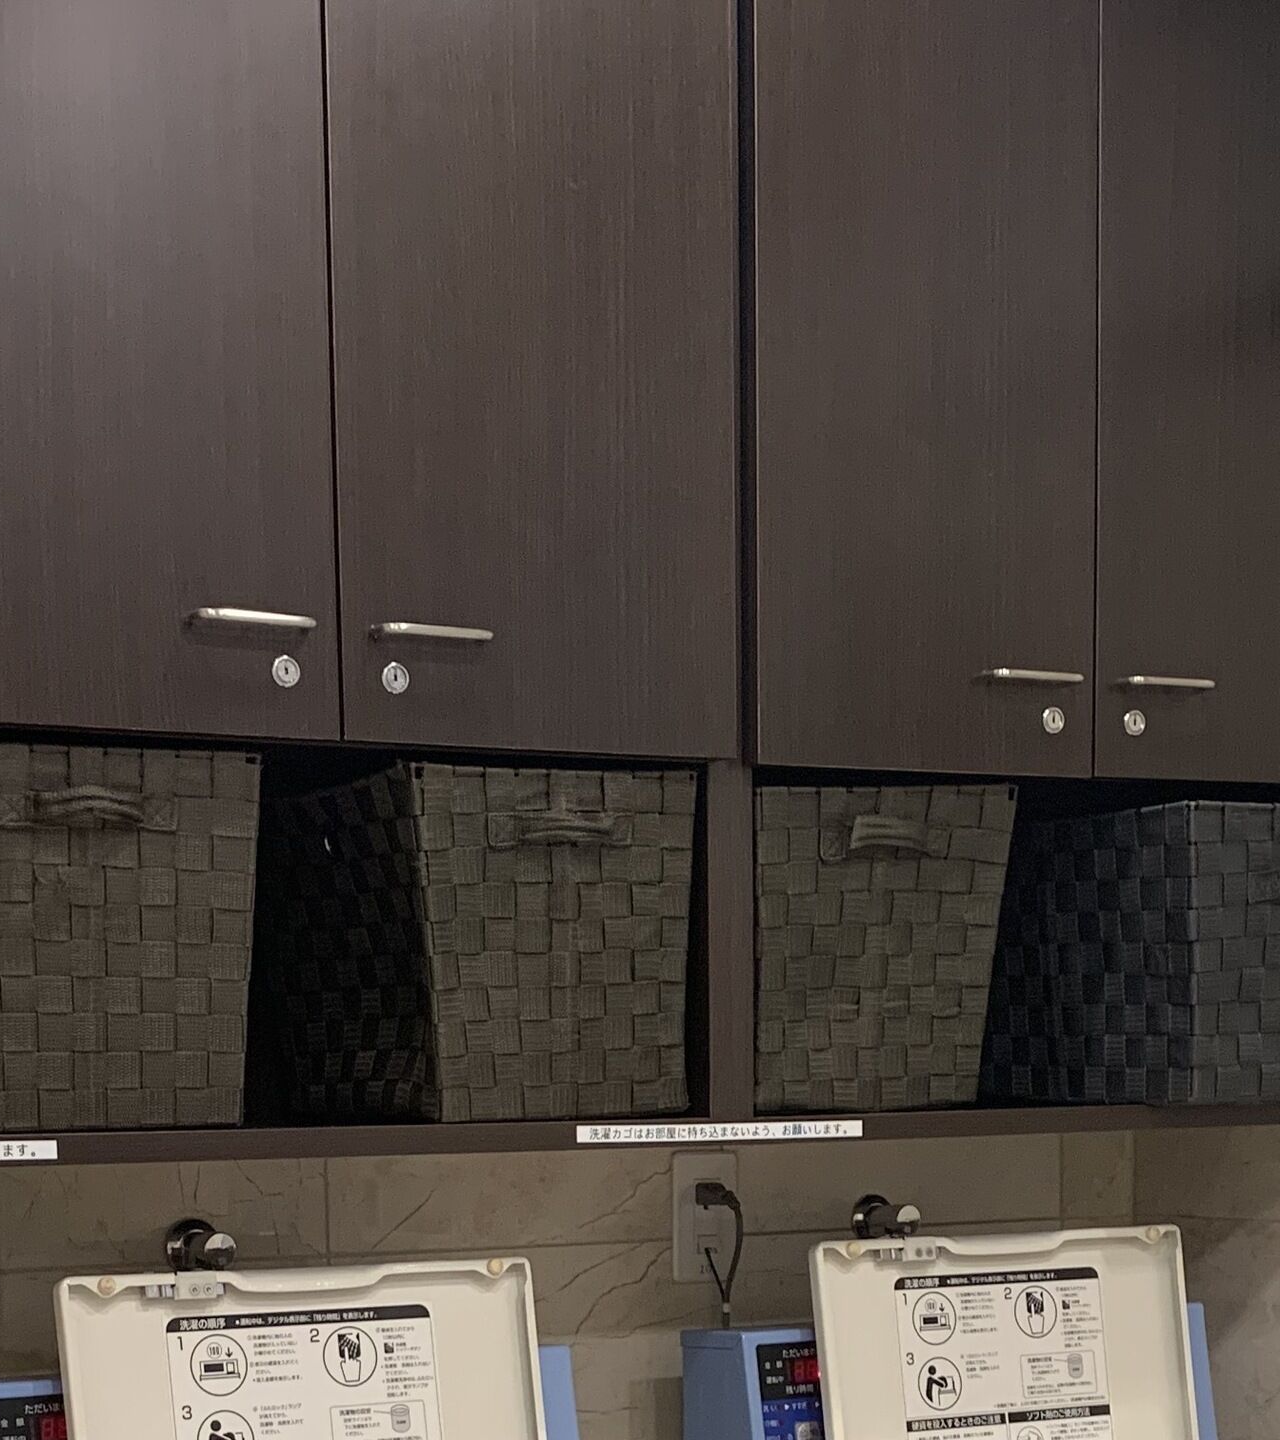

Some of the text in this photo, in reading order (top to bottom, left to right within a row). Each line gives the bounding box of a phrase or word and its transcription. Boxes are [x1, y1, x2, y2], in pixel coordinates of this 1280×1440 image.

[589, 1123, 849, 1141] 洗濯カゴはお部屋に持ち込まないよう、お願いします。
[902, 1287, 1013, 1305] 1 2
[179, 1317, 226, 1331] 洗濯の順序
[177, 1328, 320, 1351] 1 2
[905, 1352, 915, 1366] 3
[181, 1405, 193, 1420] 3
